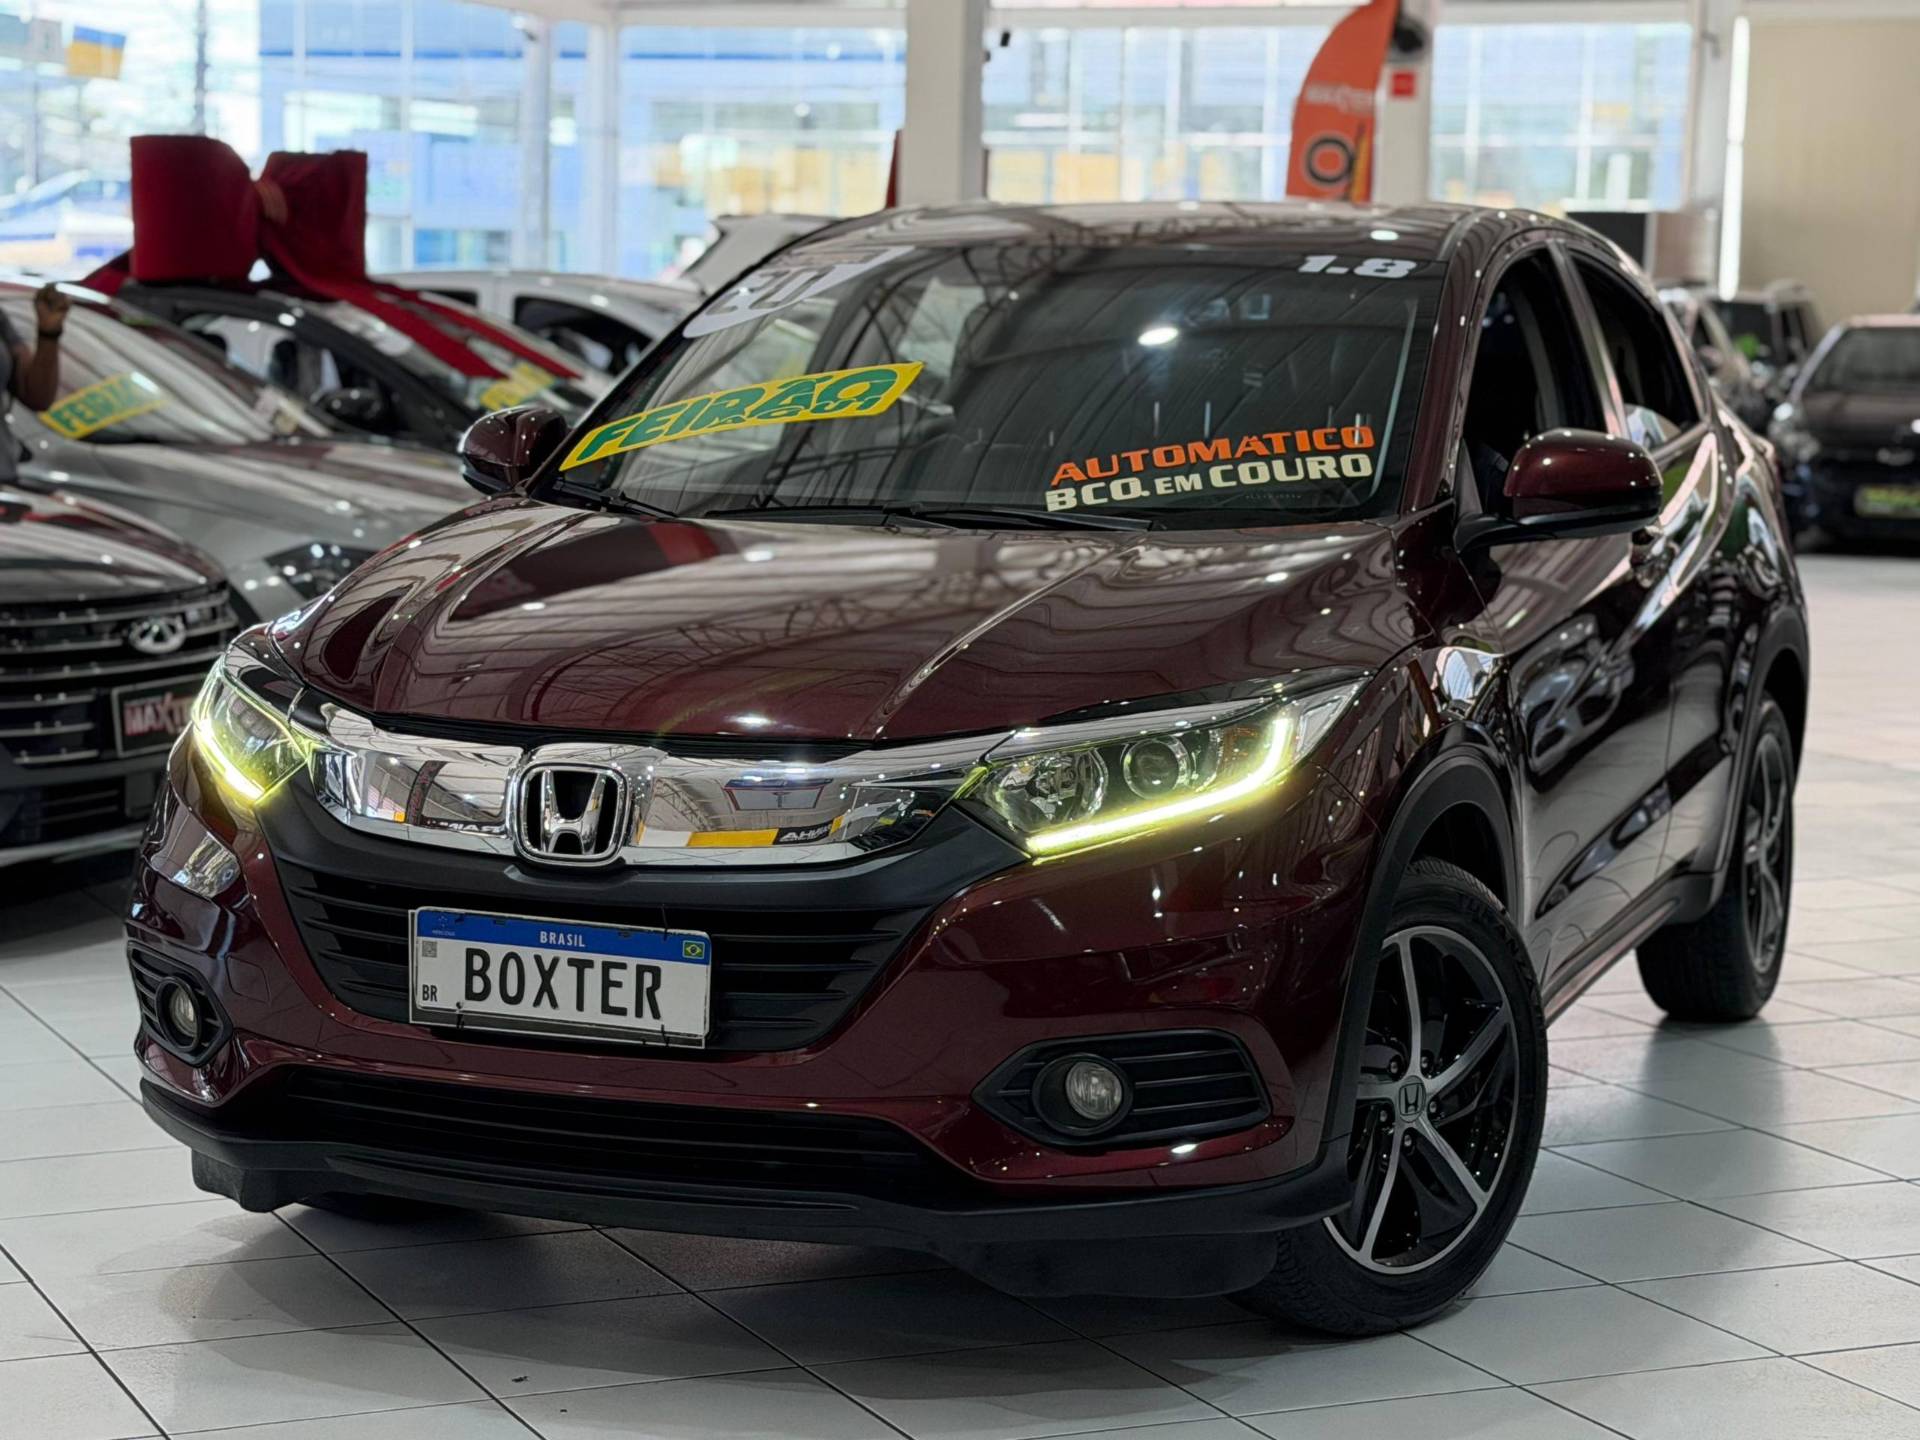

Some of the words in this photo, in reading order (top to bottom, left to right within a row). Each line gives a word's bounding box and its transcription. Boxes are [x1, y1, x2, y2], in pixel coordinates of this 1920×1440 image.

[1299, 255, 1417, 278] 1.8
[576, 369, 898, 461] FEIRÃO
[1154, 473, 1202, 496] EM
[1208, 454, 1374, 489] COURO
[540, 931, 586, 947] BRASIL
[422, 984, 438, 1002] BR
[464, 947, 661, 1020] BOXTER
